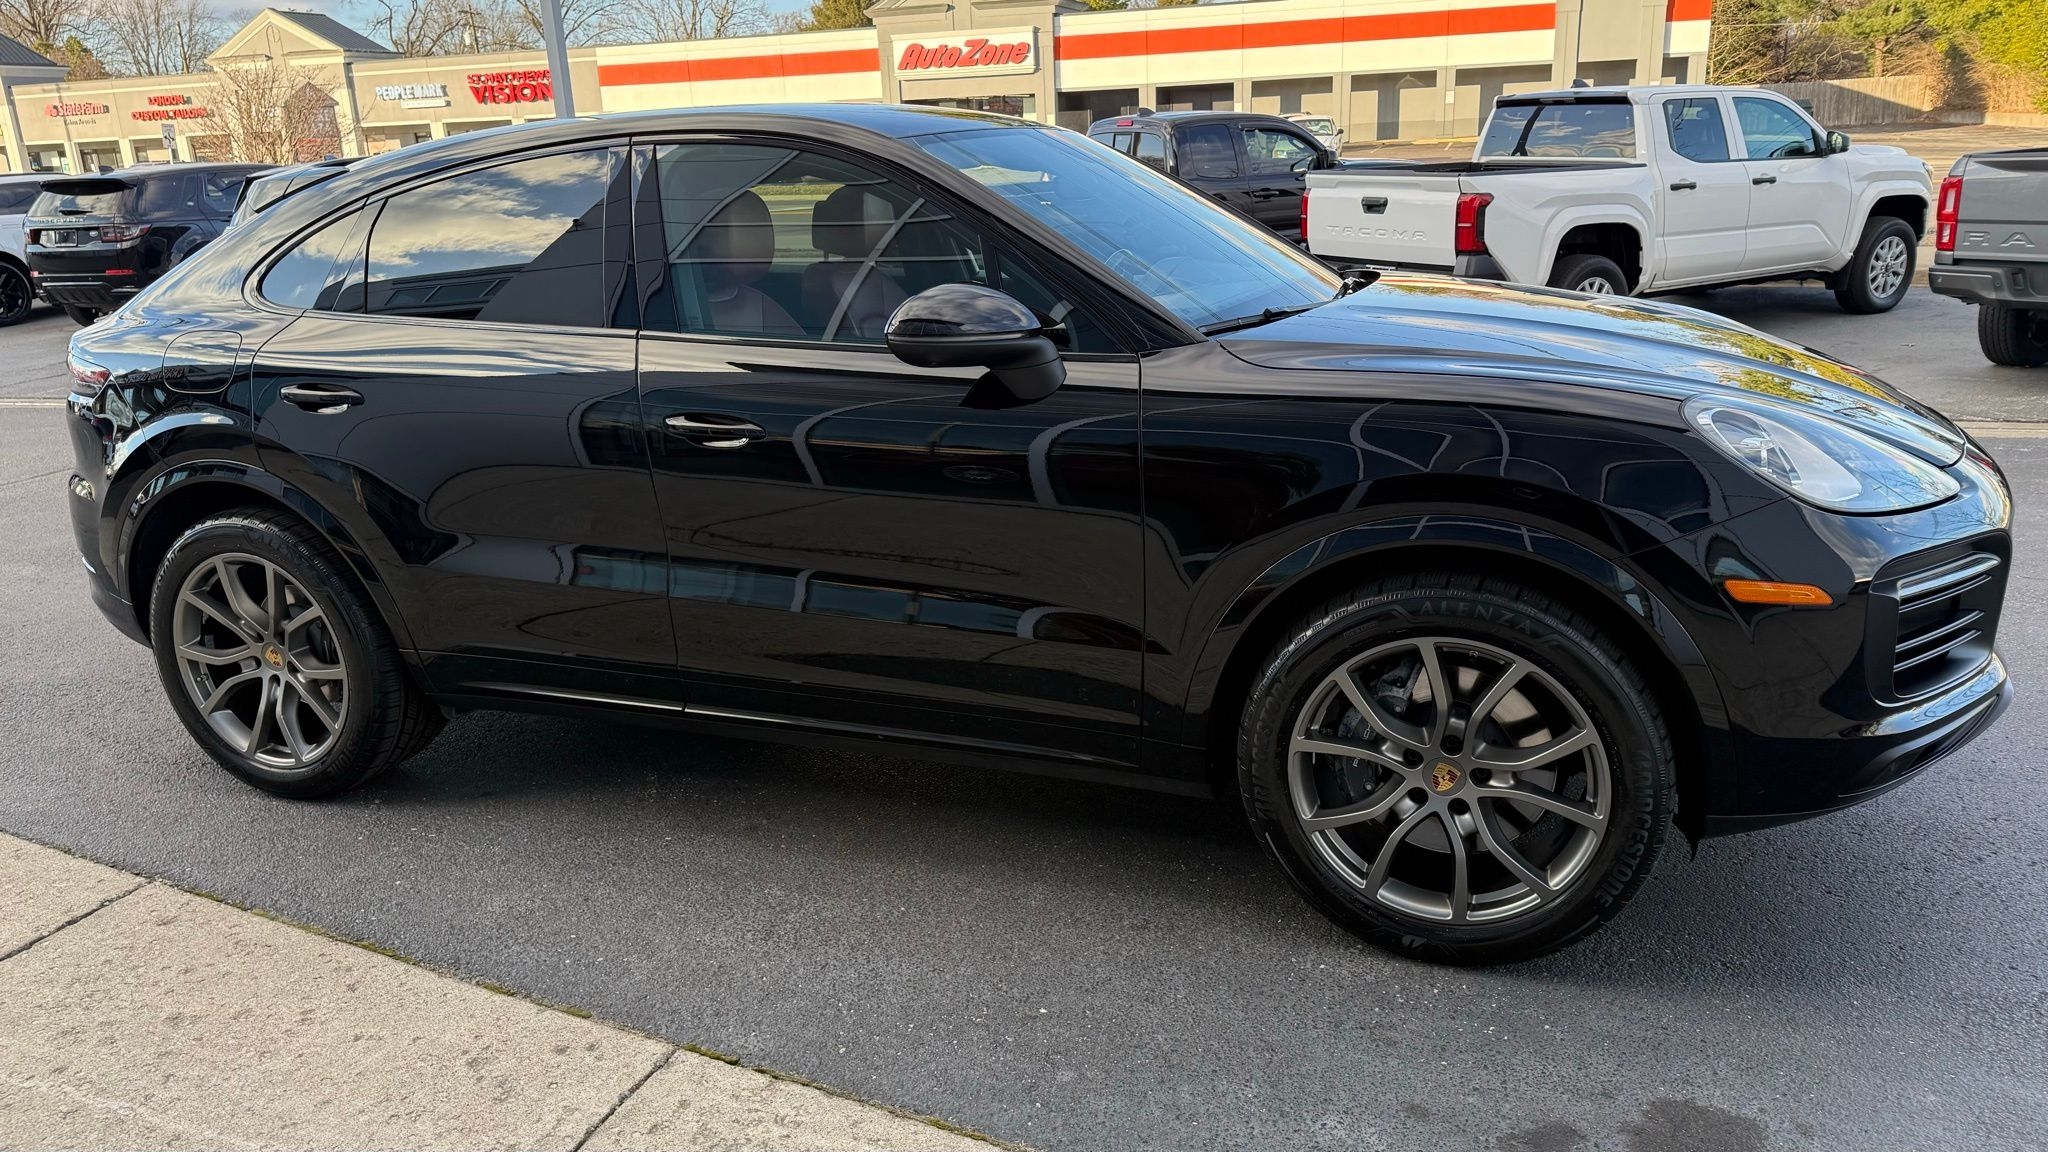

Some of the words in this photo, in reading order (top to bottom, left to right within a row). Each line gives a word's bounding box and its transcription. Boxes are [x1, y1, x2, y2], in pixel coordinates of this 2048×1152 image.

[898, 38, 1031, 70] AutoZone
[148, 95, 184, 106] LONDON
[469, 82, 554, 104] VISION
[131, 110, 168, 121] CUSTOM
[1326, 225, 1427, 241] TACOMA
[1419, 600, 1531, 633] ALENZA
